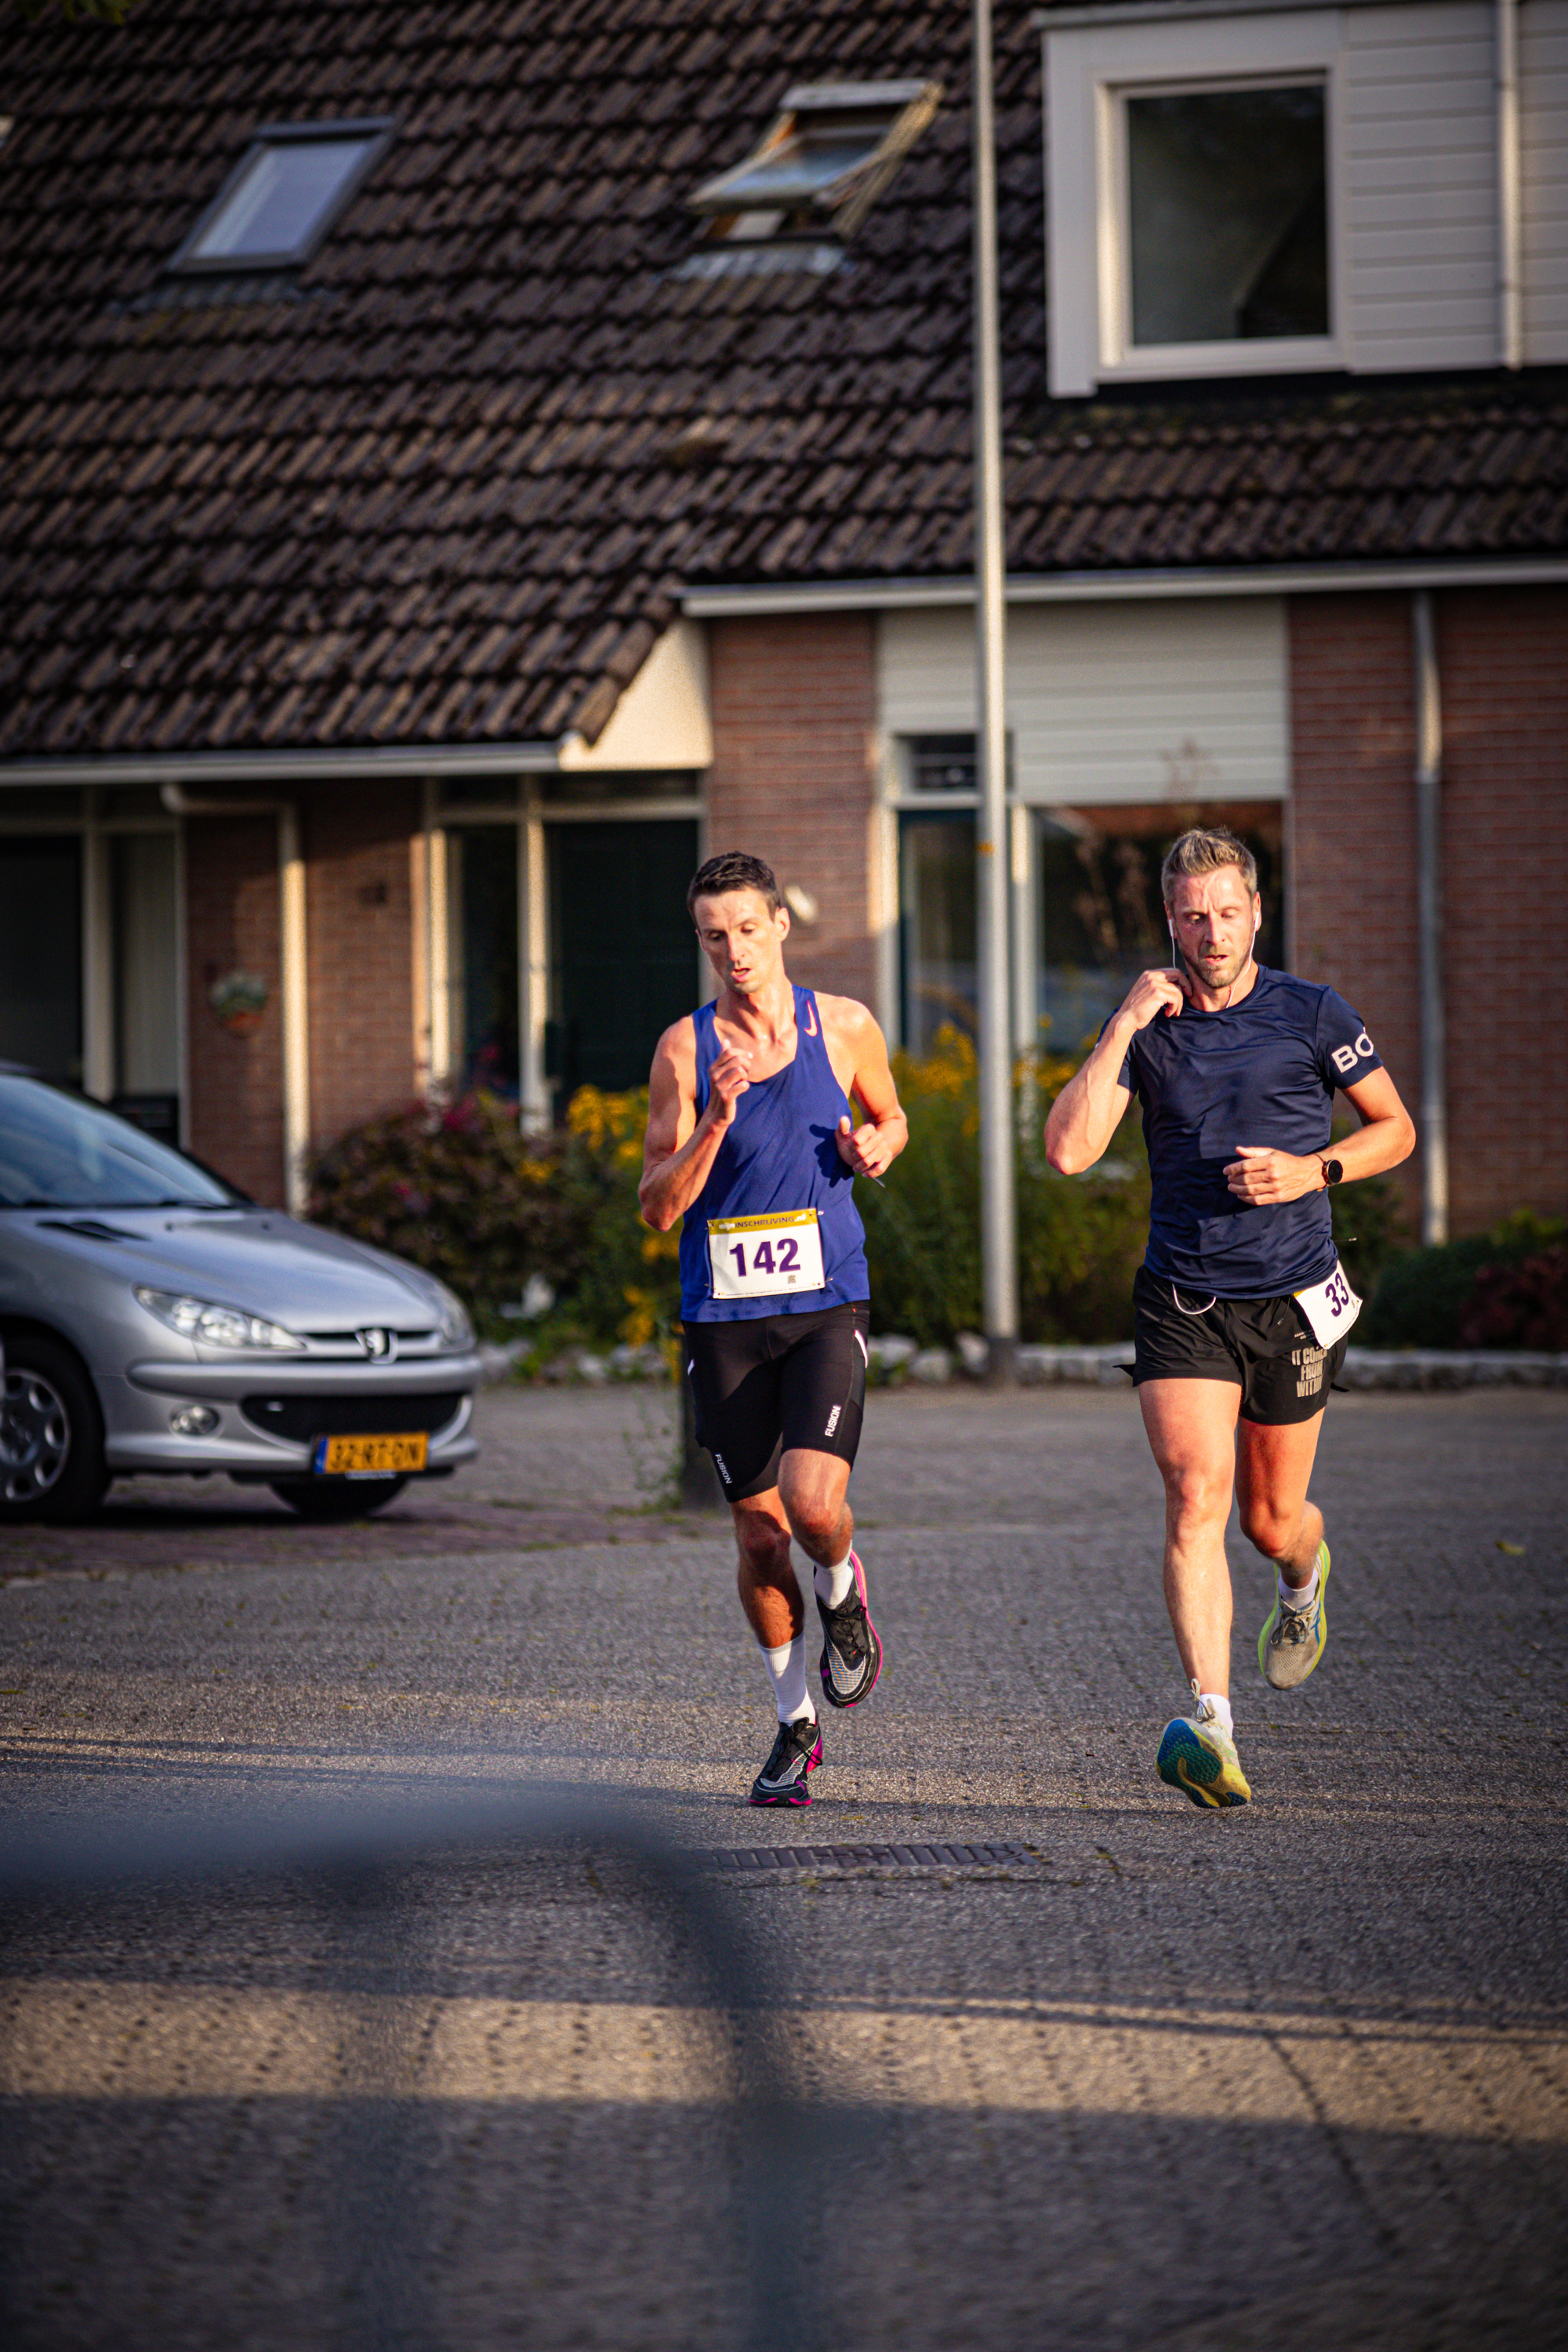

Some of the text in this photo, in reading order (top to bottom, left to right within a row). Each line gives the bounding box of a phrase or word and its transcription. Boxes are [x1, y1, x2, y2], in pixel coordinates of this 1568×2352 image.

[729, 1238, 801, 1278] 142
[1325, 1272, 1349, 1317] 33
[1292, 1349, 1301, 1366] IT
[1301, 1359, 1323, 1381] FROM
[824, 1404, 842, 1438] FUSION
[714, 1453, 732, 1485] FUSION
